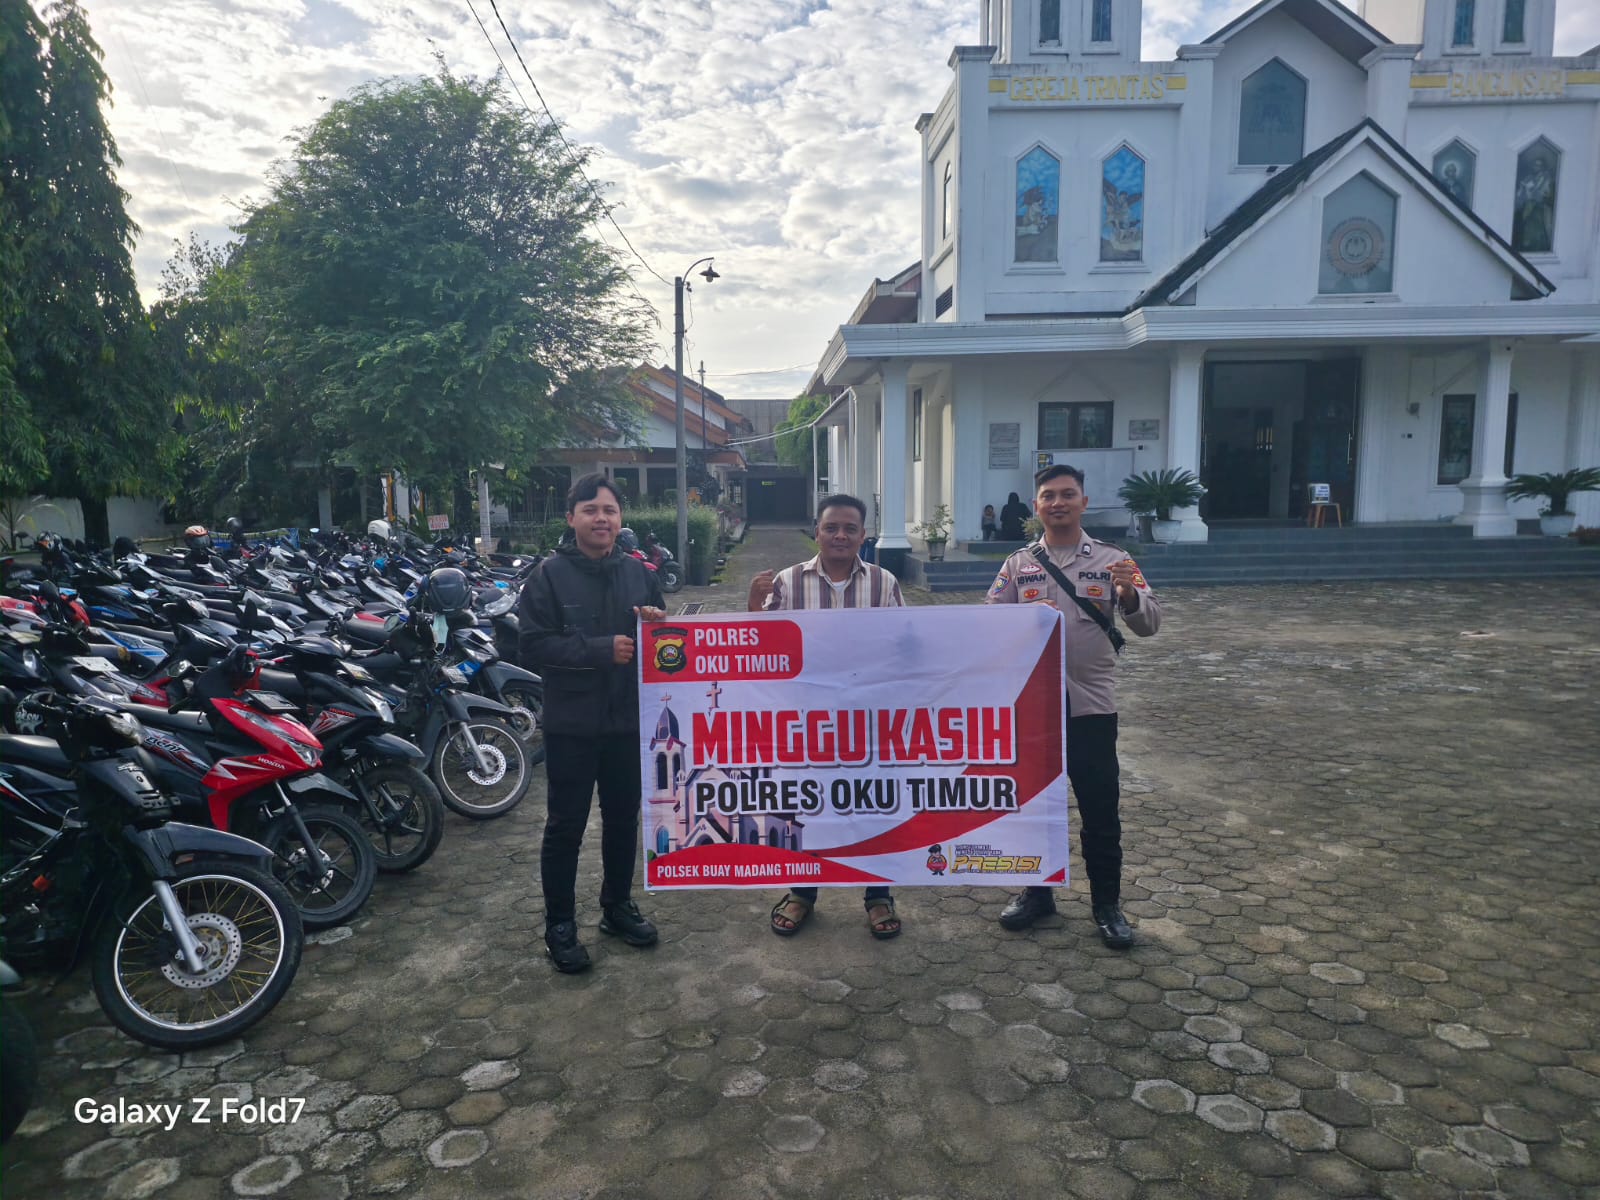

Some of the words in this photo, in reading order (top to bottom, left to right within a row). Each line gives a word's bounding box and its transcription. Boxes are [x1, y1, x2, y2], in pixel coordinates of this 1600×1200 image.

[1084, 74, 1165, 100] TRINITAS
[1078, 571, 1111, 581] POLRI
[694, 628, 759, 647] POLRES
[695, 655, 729, 674] OKU
[735, 654, 790, 673] TIMUR
[692, 709, 866, 765] MINGGU
[878, 707, 1012, 761] KASIH
[257, 755, 286, 771] HONDA
[696, 779, 819, 813] POLRES
[831, 779, 895, 810] OKU
[907, 778, 1015, 808] TIMUR
[657, 865, 699, 878] POLSEK
[703, 864, 731, 877] BUAY
[734, 864, 781, 877] MADANG
[785, 863, 821, 875] TIMUR
[952, 856, 1042, 872] PRESISI
